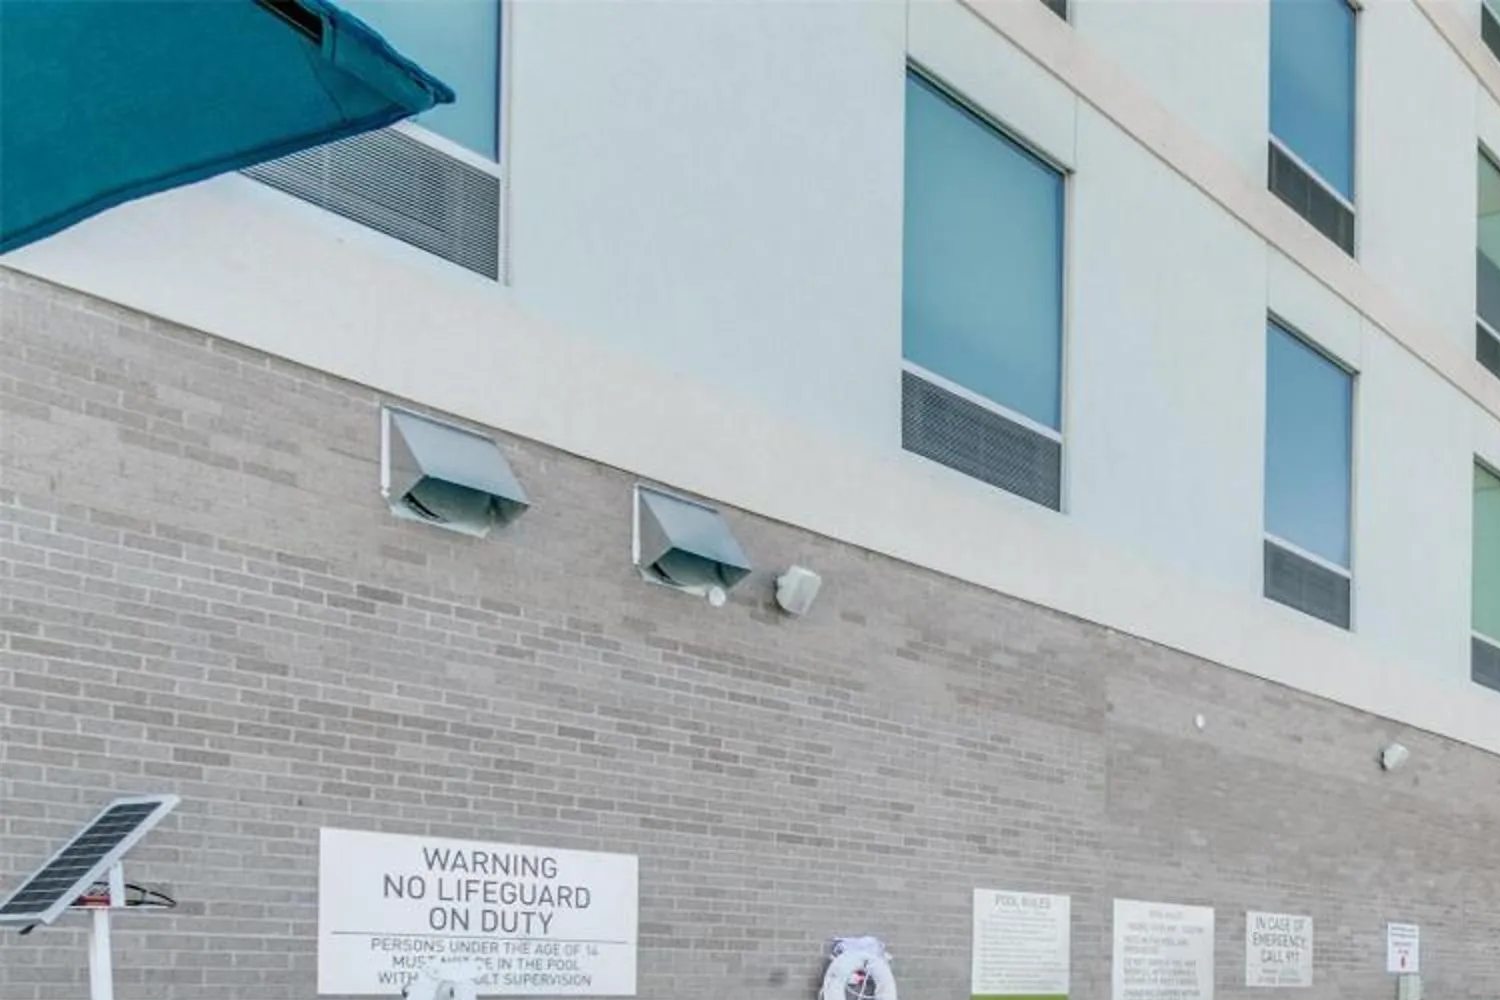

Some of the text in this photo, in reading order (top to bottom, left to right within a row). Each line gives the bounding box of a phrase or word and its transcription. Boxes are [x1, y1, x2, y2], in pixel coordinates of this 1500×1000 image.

[423, 847, 557, 879] WARNING
[384, 874, 591, 909] NO LIFEGUARD
[429, 907, 553, 934] ON DUTY
[1256, 915, 1265, 929] IN
[371, 938, 444, 953] PERSONS
[450, 941, 498, 955] UNDER
[503, 942, 529, 955] THE
[535, 943, 559, 956] AGE
[564, 944, 580, 956] OF
[1252, 930, 1306, 949] EMERGENCY
[498, 958, 512, 970] IN
[518, 958, 543, 971] THE
[548, 959, 579, 971] POOL
[504, 973, 592, 987] SUPERVISION
